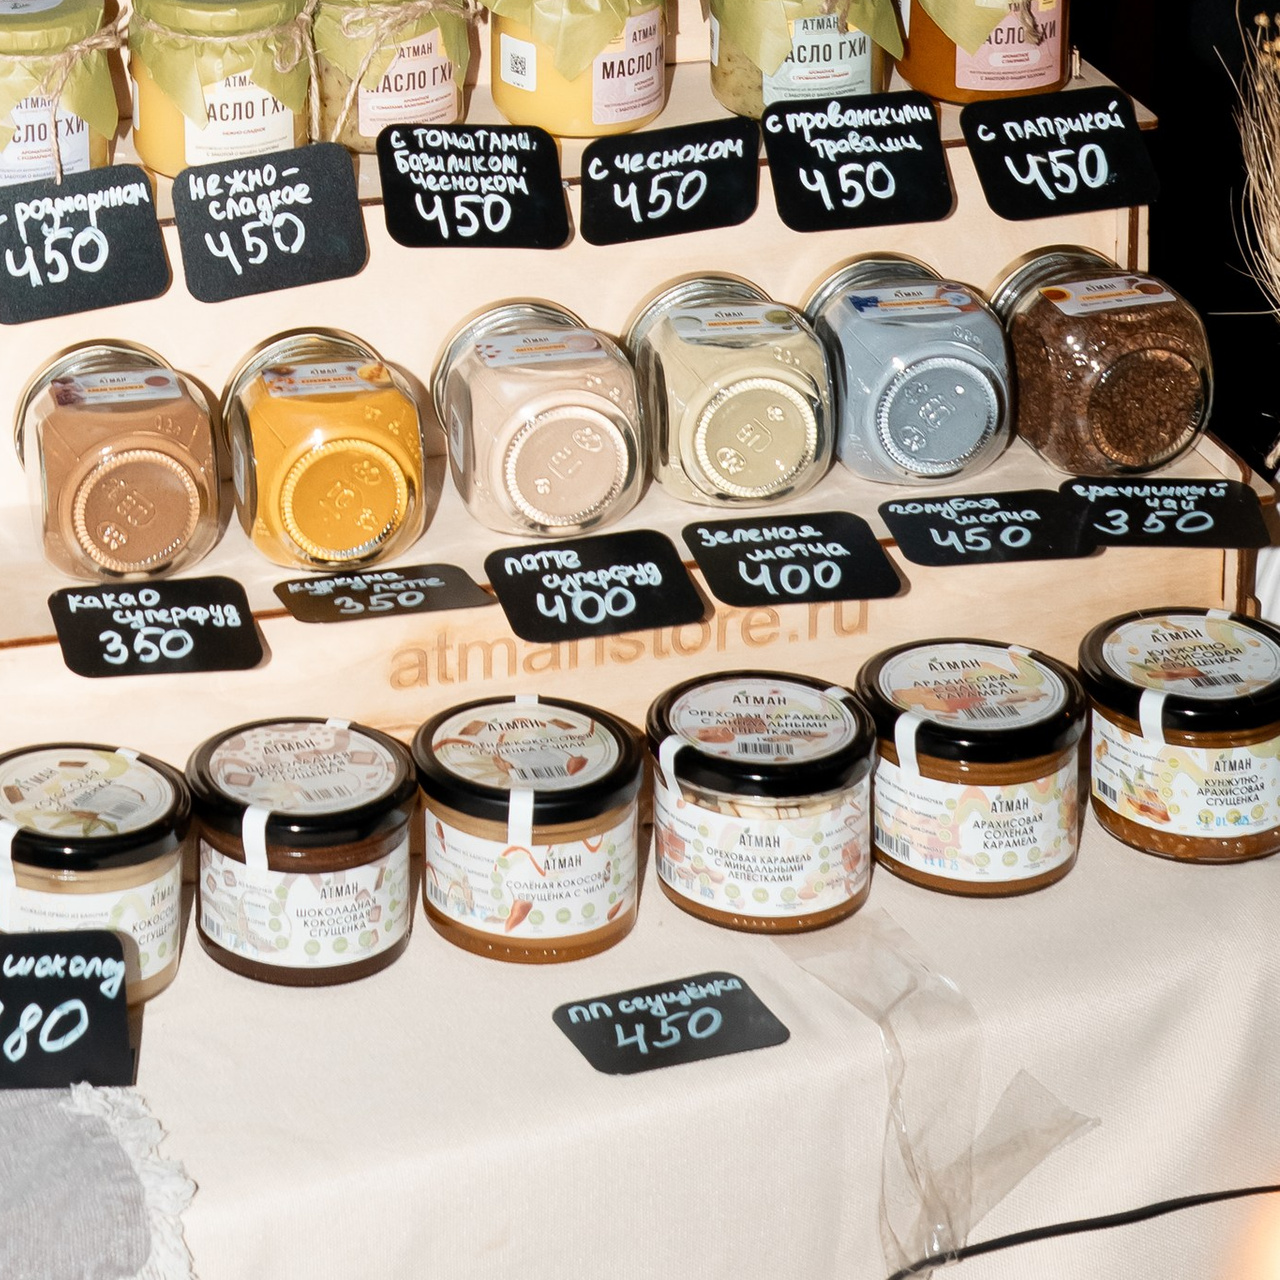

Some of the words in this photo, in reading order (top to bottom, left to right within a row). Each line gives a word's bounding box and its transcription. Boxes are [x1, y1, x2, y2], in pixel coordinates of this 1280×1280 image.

[632, 24, 656, 43] АТМАН
[399, 42, 432, 58] АТМАН
[839, 36, 866, 60] ГХИ
[602, 52, 651, 79] МАСЛО
[1005, 143, 1110, 201] 450
[799, 161, 896, 211] 450
[613, 170, 707, 224] 450
[415, 194, 512, 238] 450
[204, 212, 306, 276] 450
[5, 228, 109, 288] 450
[1095, 509, 1214, 536] 350
[931, 525, 1032, 555] 450
[738, 559, 842, 596] 400
[334, 590, 426, 614] 350
[536, 589, 636, 626] 400
[1151, 629, 1203, 644] АТМАН
[98, 628, 194, 666] 350
[928, 658, 981, 673] АТМАН
[733, 694, 787, 705] АТМАН
[488, 719, 540, 732] АТМАН
[263, 739, 316, 755] АТМАН
[1214, 757, 1252, 773] АТМАН
[1196, 783, 1265, 797] АРАХИСОВАЯ
[990, 797, 1029, 813] АТМАН
[973, 813, 1044, 830] АРАХИСОВАЯ
[739, 833, 780, 848] АТМАН
[982, 837, 1038, 850] КАРАМЕЛЬ
[543, 853, 582, 871] АТМАН
[706, 846, 757, 863] ОРЕХОВАЯ
[760, 854, 812, 863] КАРАМЕЛЬ
[724, 860, 804, 873] МИНДАЛЬНЫМИ
[728, 871, 793, 882] ЛЕПЕСТКАМИ
[320, 882, 359, 900] АТМАН
[296, 897, 377, 918] ШОКОЛАДНАЯ
[615, 1006, 723, 1054] 450
